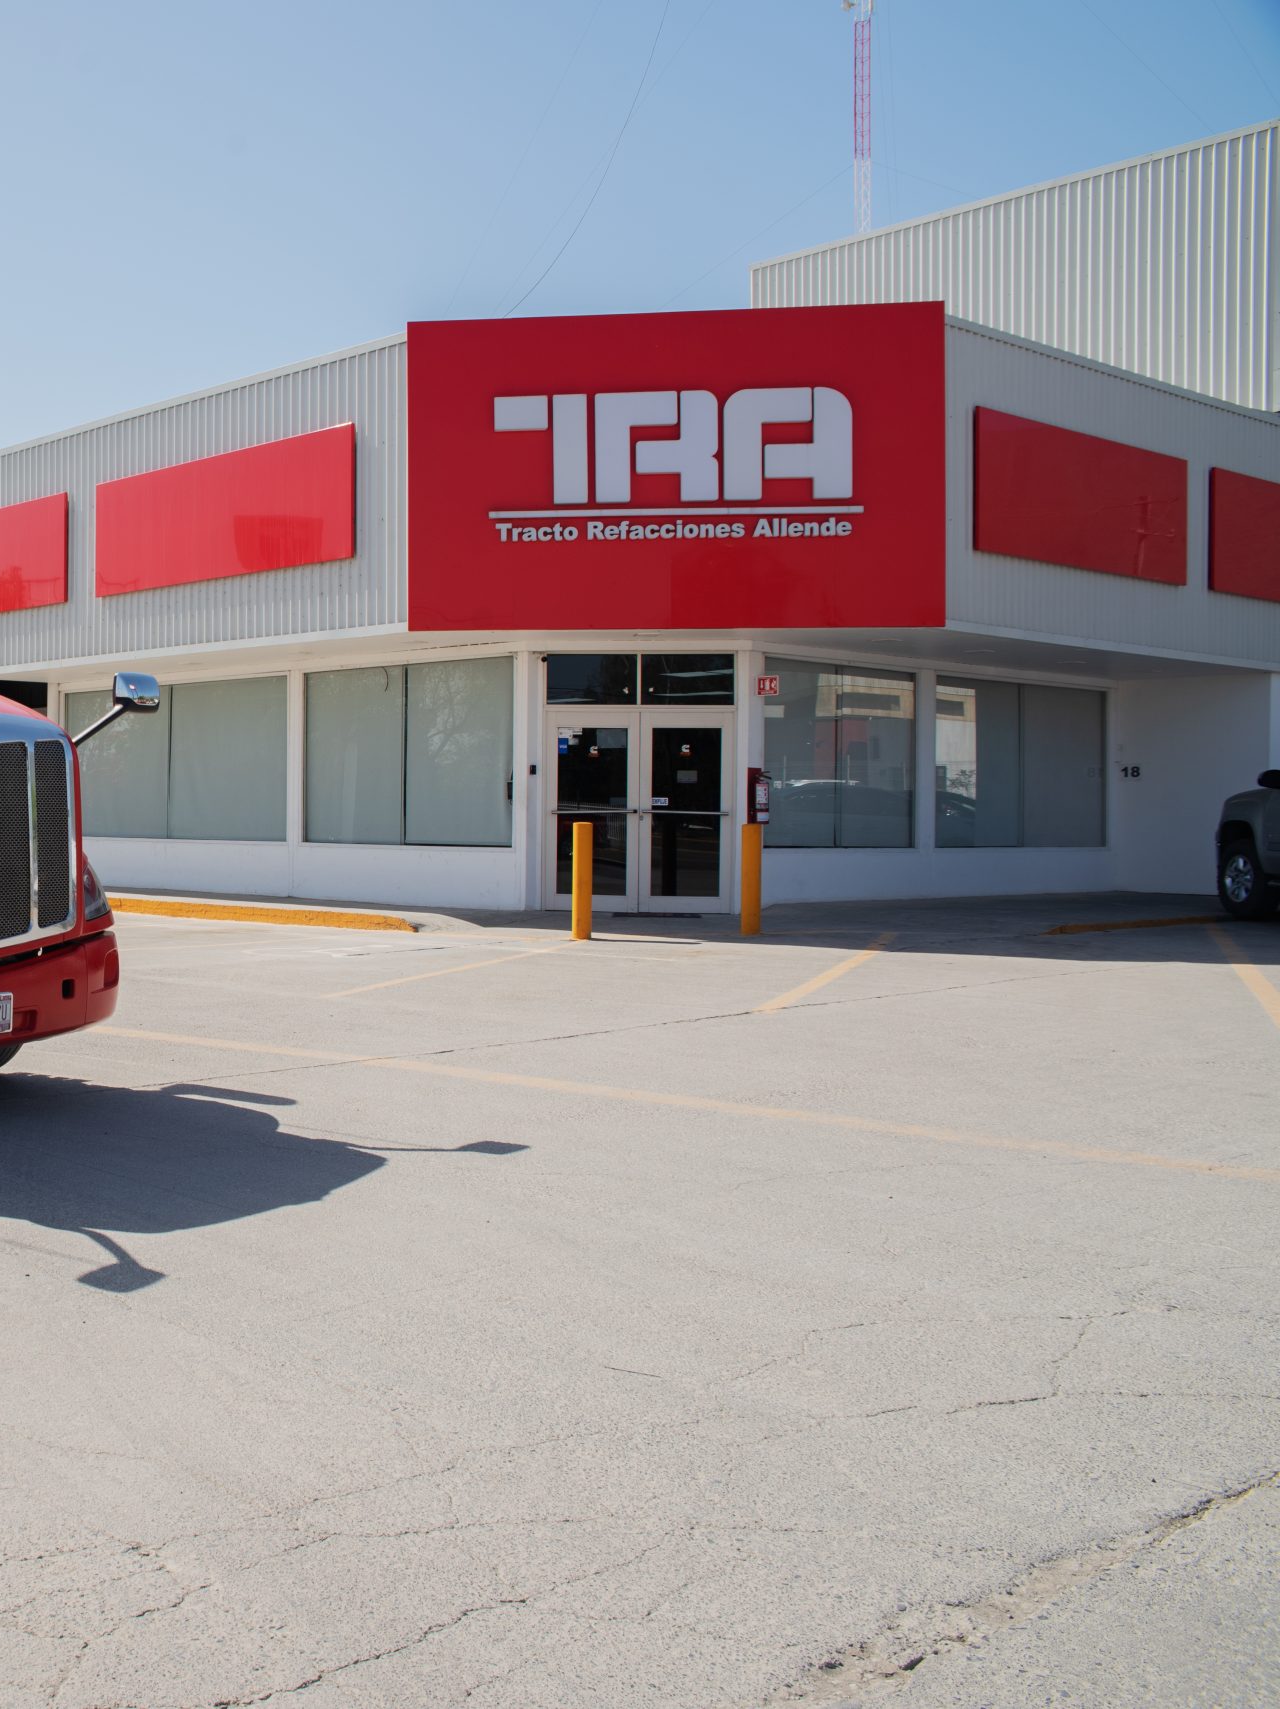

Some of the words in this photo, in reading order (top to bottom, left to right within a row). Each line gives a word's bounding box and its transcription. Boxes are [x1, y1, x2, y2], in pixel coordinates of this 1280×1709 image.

[494, 387, 853, 505] TRA
[496, 522, 579, 542] Tracto
[587, 519, 746, 541] Refacciones
[753, 517, 852, 538] Allende
[1120, 766, 1141, 778] 18
